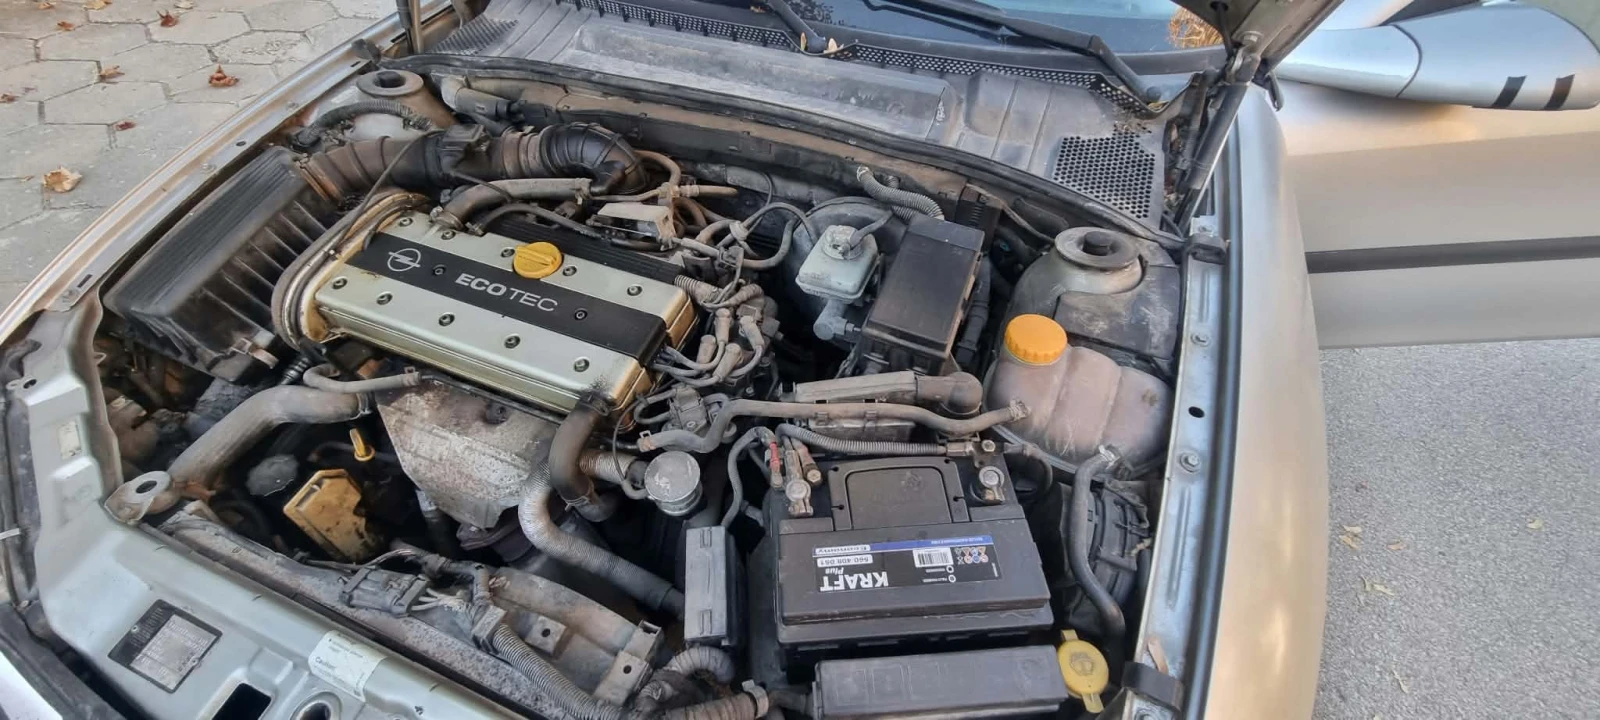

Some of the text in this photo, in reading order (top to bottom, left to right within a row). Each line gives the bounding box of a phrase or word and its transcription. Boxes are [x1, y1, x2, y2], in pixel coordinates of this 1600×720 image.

[455, 272, 559, 312] ECOTEC
[825, 566, 844, 575] Plus
[819, 571, 889, 592] KRAFT
